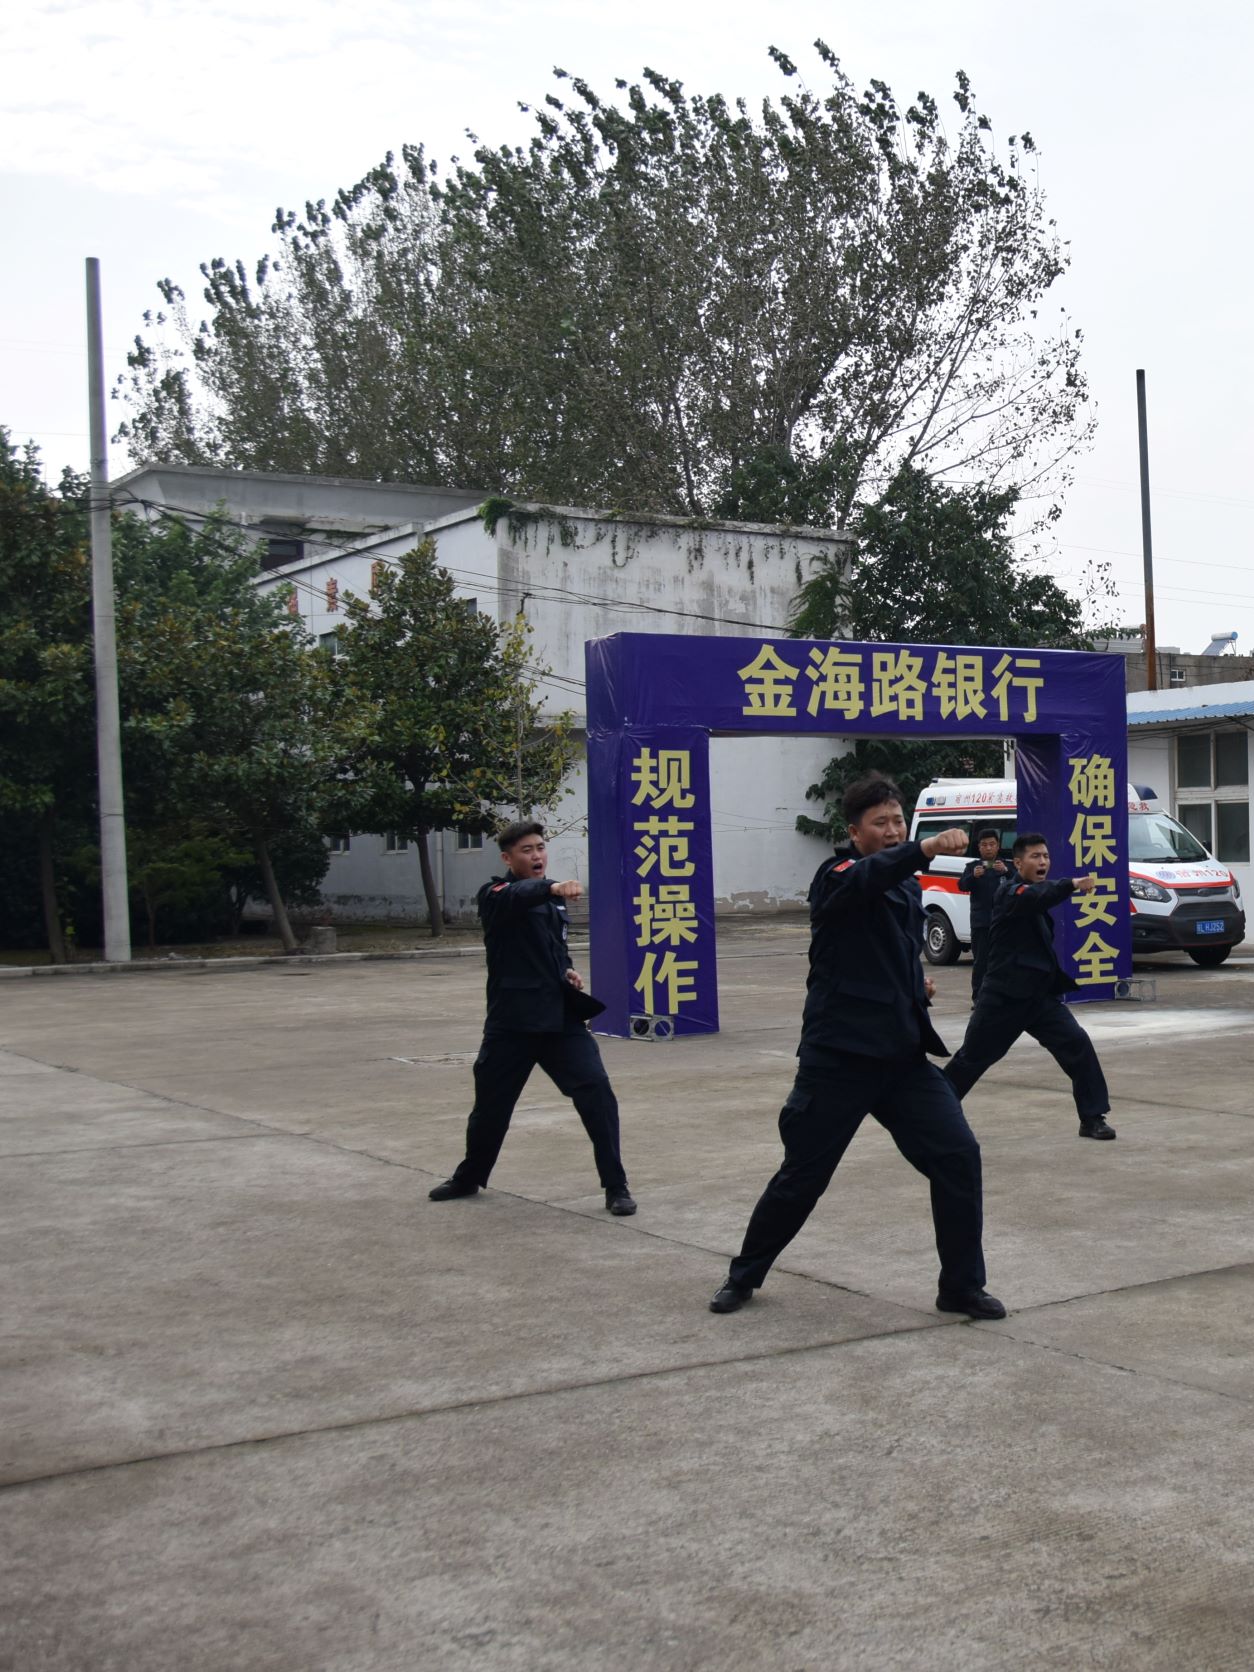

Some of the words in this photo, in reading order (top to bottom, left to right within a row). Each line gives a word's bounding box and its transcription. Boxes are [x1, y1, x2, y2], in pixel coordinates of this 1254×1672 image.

[737, 643, 1044, 722] 金海路银行
[631, 747, 698, 1015] 规范操作
[1068, 754, 1120, 986] 确保安全
